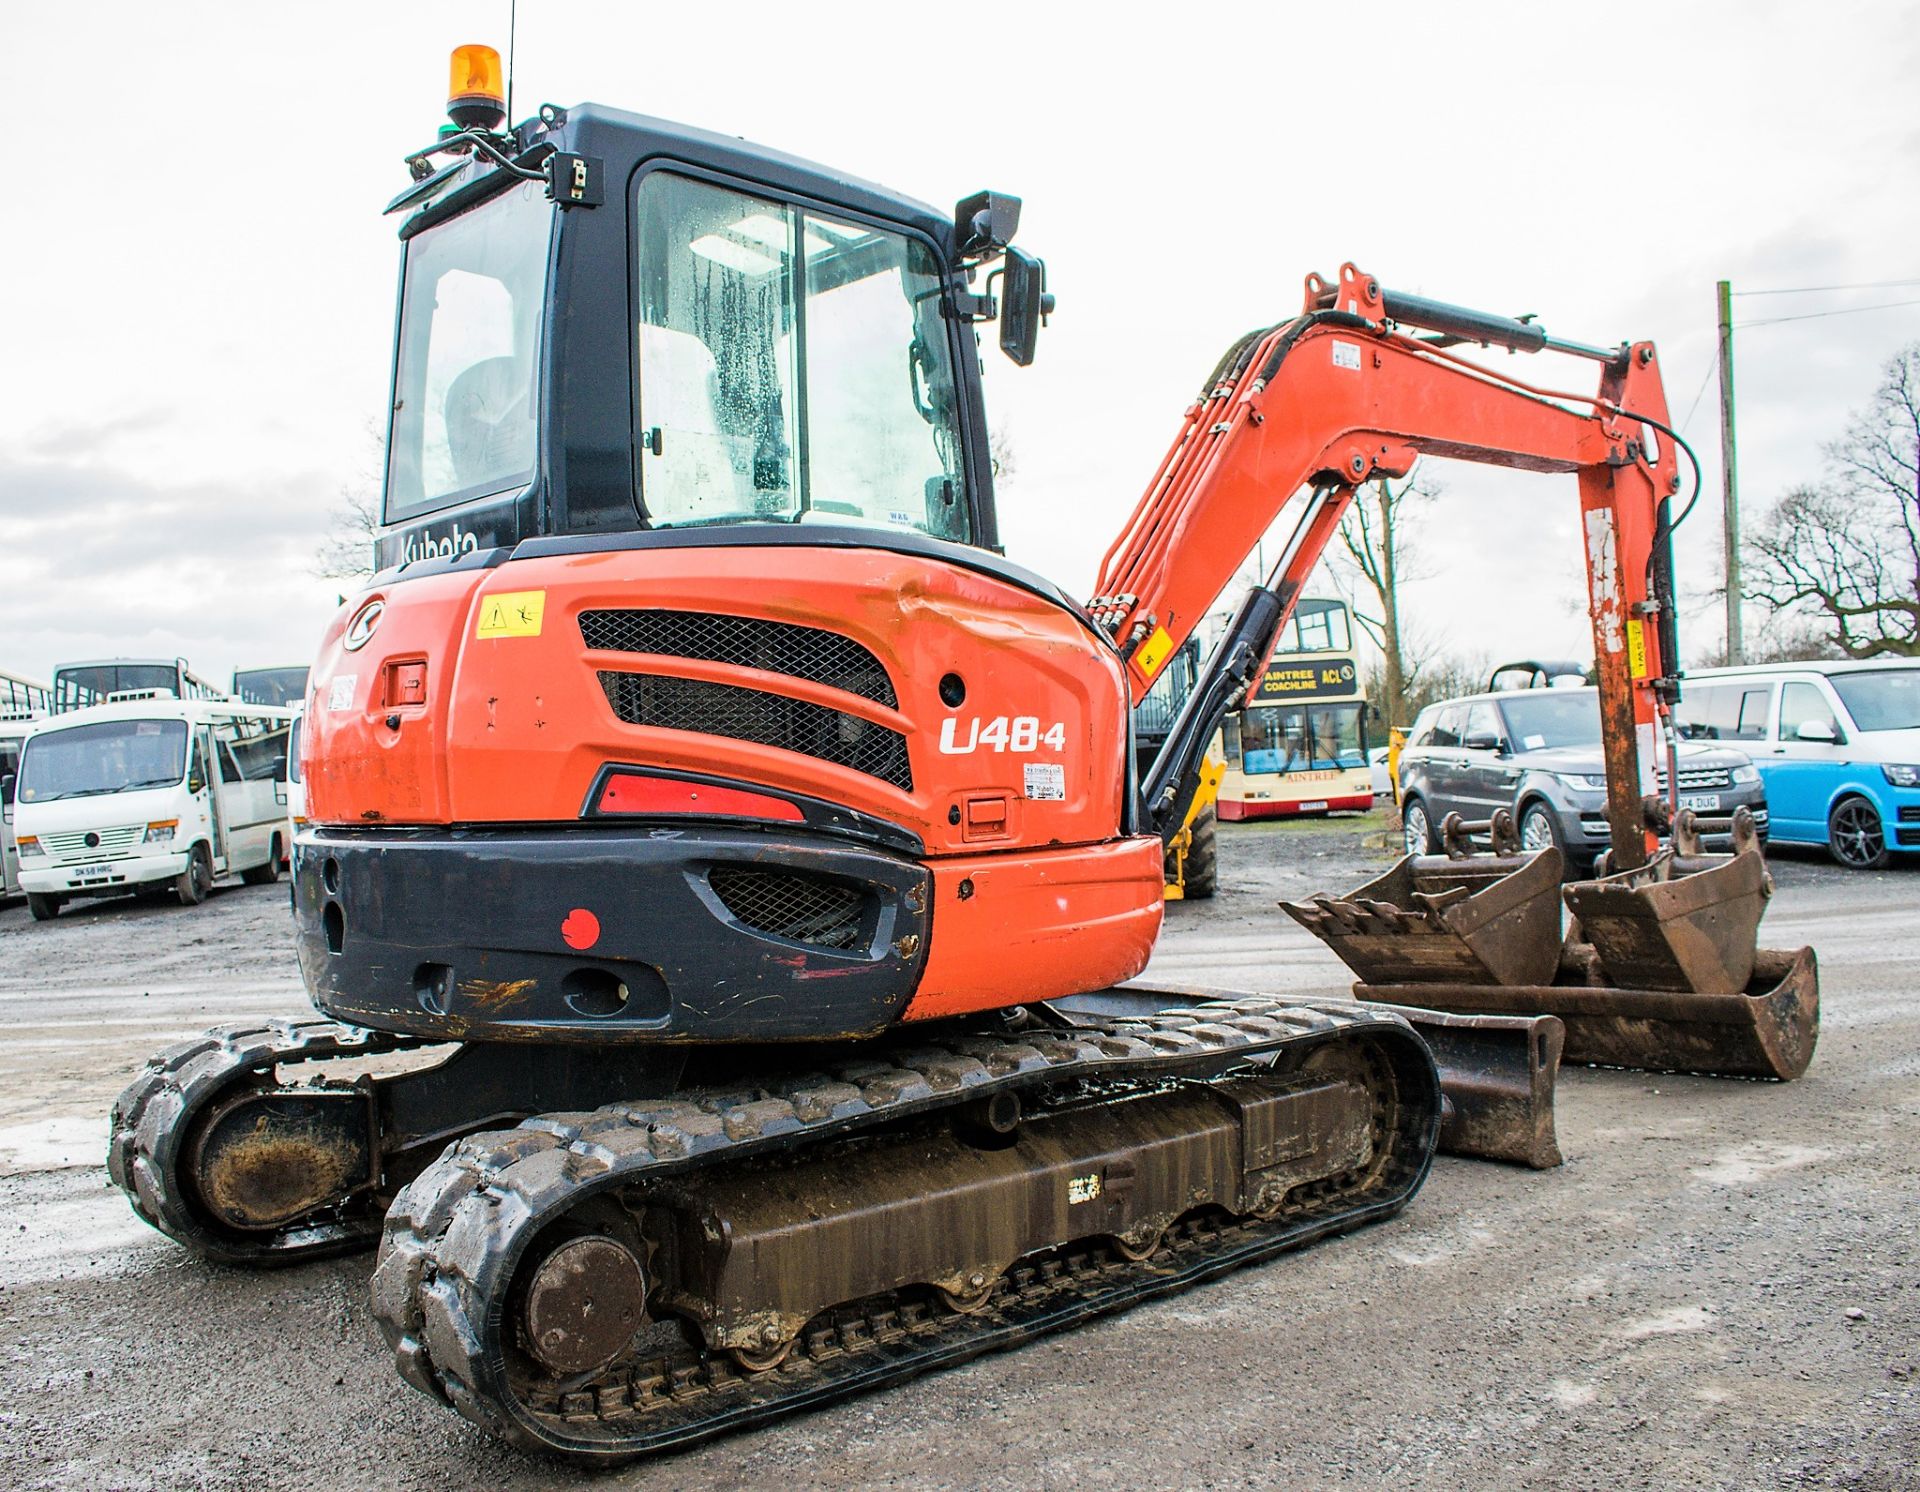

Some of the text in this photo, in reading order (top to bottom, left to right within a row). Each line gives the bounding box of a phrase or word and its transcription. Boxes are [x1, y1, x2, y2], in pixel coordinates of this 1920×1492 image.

[400, 523, 479, 564] Kubota
[1265, 669, 1315, 681] AINTREE
[1321, 669, 1343, 684] ACL
[1264, 680, 1317, 692] COACHLINE
